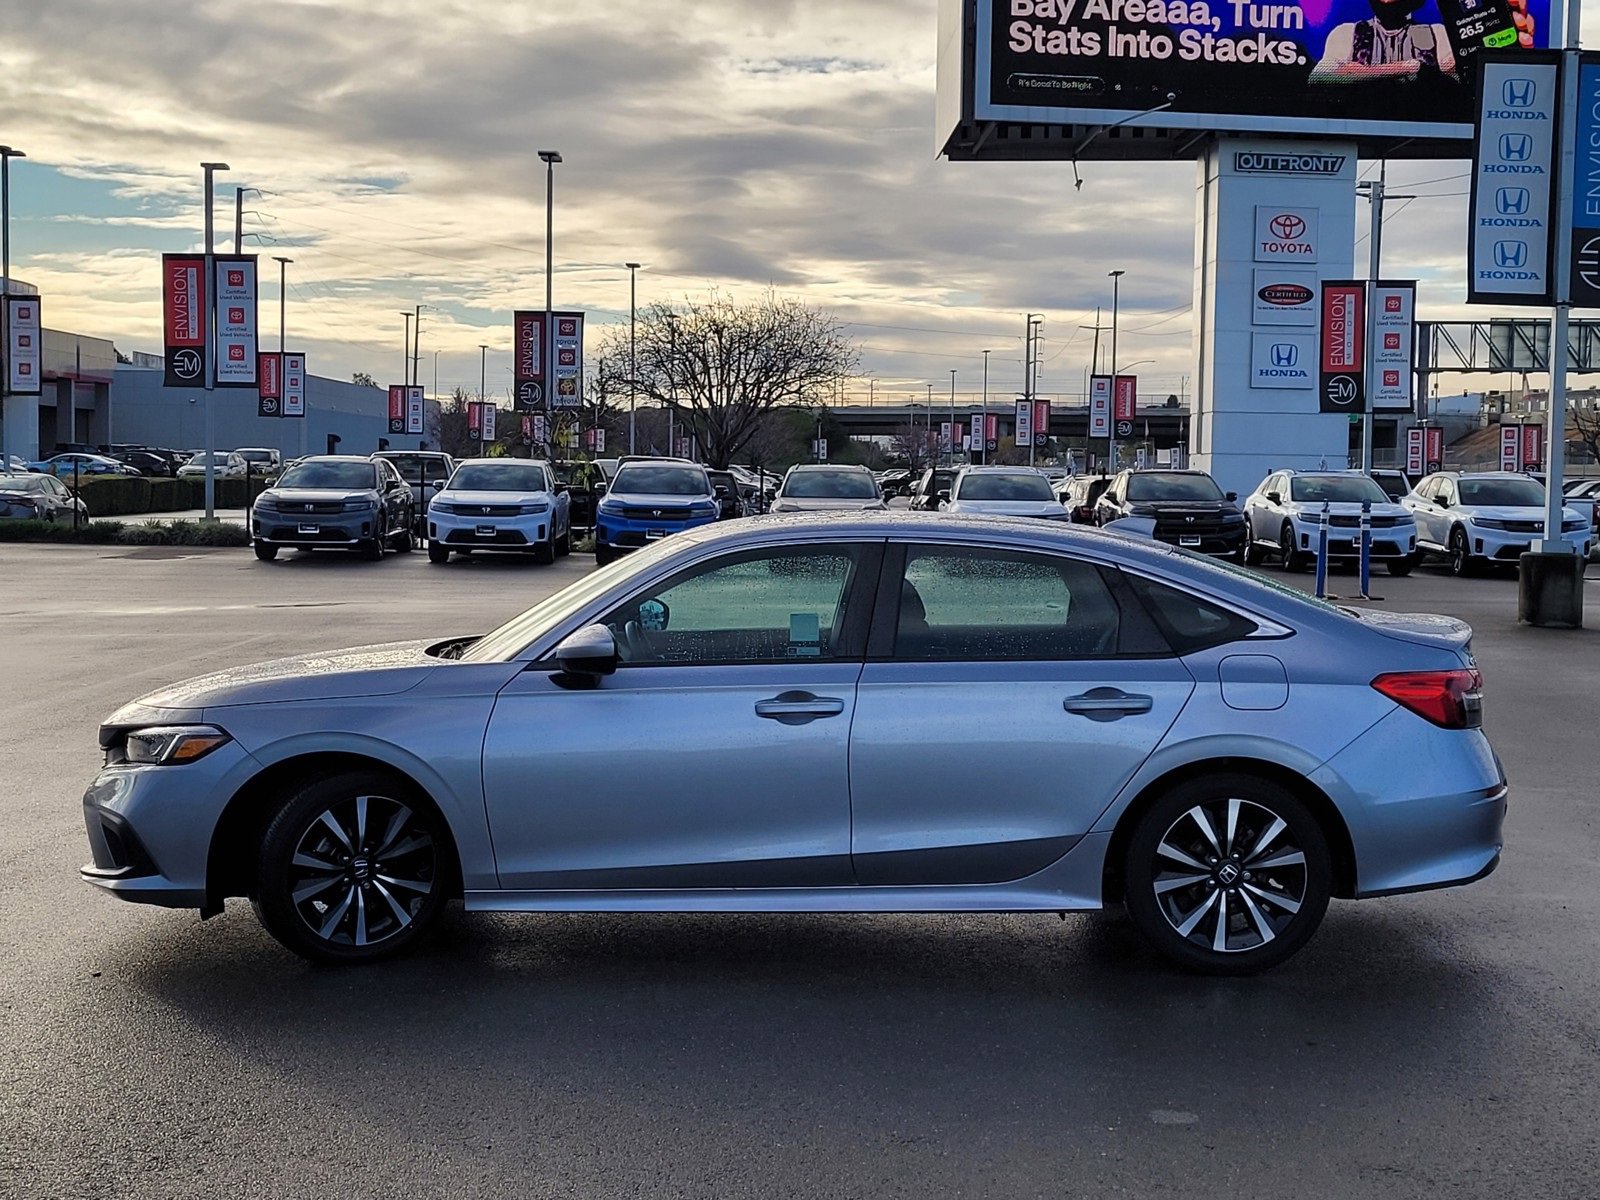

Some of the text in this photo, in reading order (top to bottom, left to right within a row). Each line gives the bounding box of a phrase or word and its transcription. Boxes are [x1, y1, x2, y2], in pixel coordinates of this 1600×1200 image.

[1010, 0, 1304, 32] Bay Areaaa, Turn
[1459, 21, 1485, 40] 26.5
[1008, 21, 1306, 66] Stats Into Stacks.
[1486, 110, 1548, 121] HONDA
[1483, 164, 1545, 174] HONDA
[1480, 218, 1543, 228] HONDA
[1261, 242, 1313, 254] TOYOTA
[1479, 270, 1541, 280] HONDA
[174, 267, 188, 340] ENVISION
[1330, 294, 1345, 366] ENVISION
[522, 321, 533, 375] ENVISION
[1258, 368, 1308, 378] HONDA
